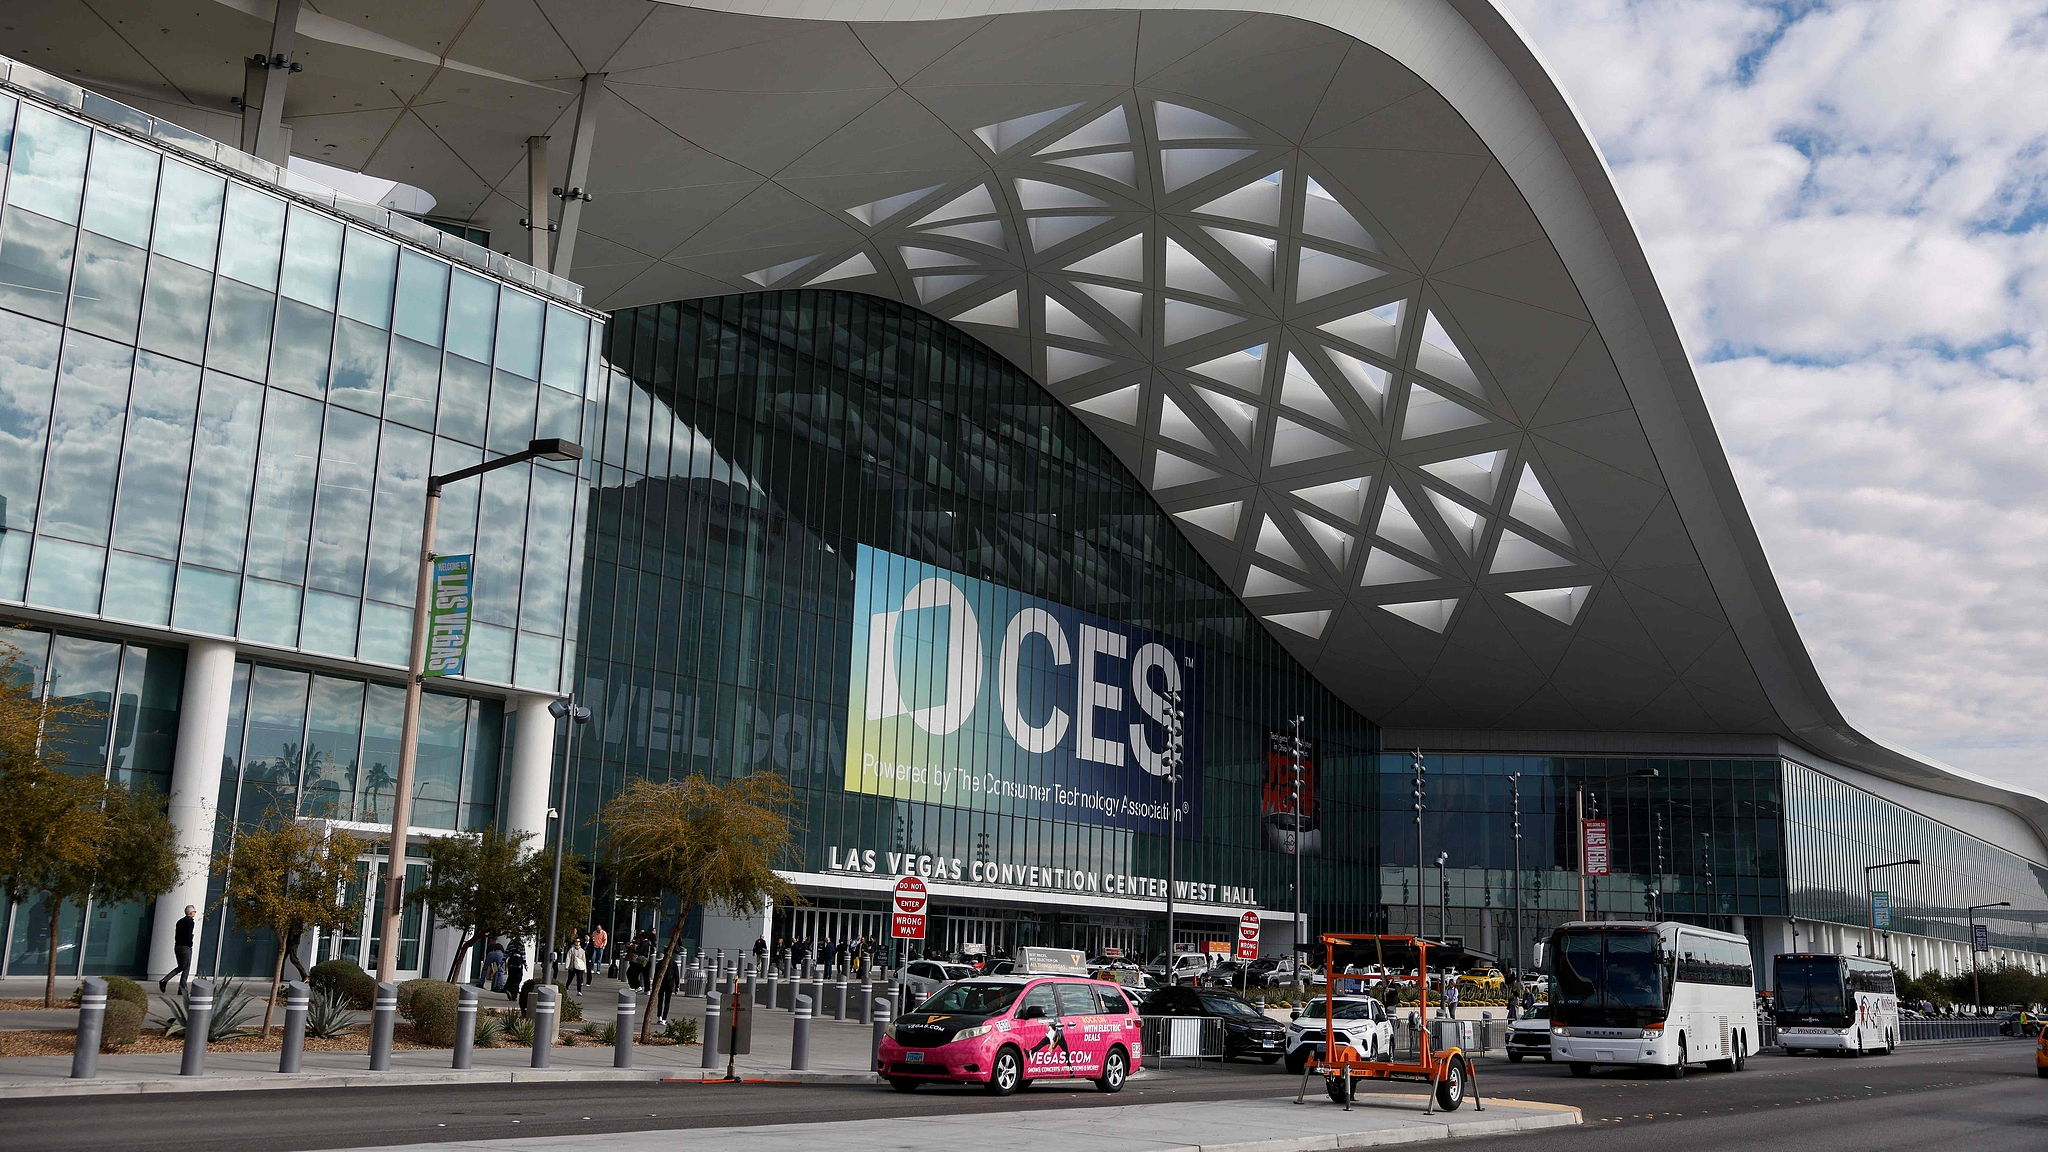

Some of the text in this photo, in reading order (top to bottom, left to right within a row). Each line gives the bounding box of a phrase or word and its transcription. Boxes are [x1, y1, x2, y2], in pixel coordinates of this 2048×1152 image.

[437, 561, 468, 572] WELCOME TO
[428, 574, 469, 671] LAS VEGAS
[862, 751, 932, 786] Powered
[933, 764, 951, 793] by
[953, 767, 980, 792] The
[982, 773, 1051, 804] Consumer
[1051, 784, 1120, 818] Technology
[1586, 828, 1607, 873] LAS VEGAS
[828, 845, 1258, 906] LAS VEGAS CONVENTION CENTER WEST HALL
[900, 900, 920, 908] ENTER
[896, 916, 922, 926] WRONG
[900, 926, 917, 935] WAY
[1240, 942, 1257, 950] WRONG
[1081, 1016, 1097, 1024] ROCK
[1083, 1024, 1122, 1033] WITH ELECTRIC
[1083, 1033, 1101, 1042] DEALS
[1028, 1050, 1093, 1065] VEGAS.COM
